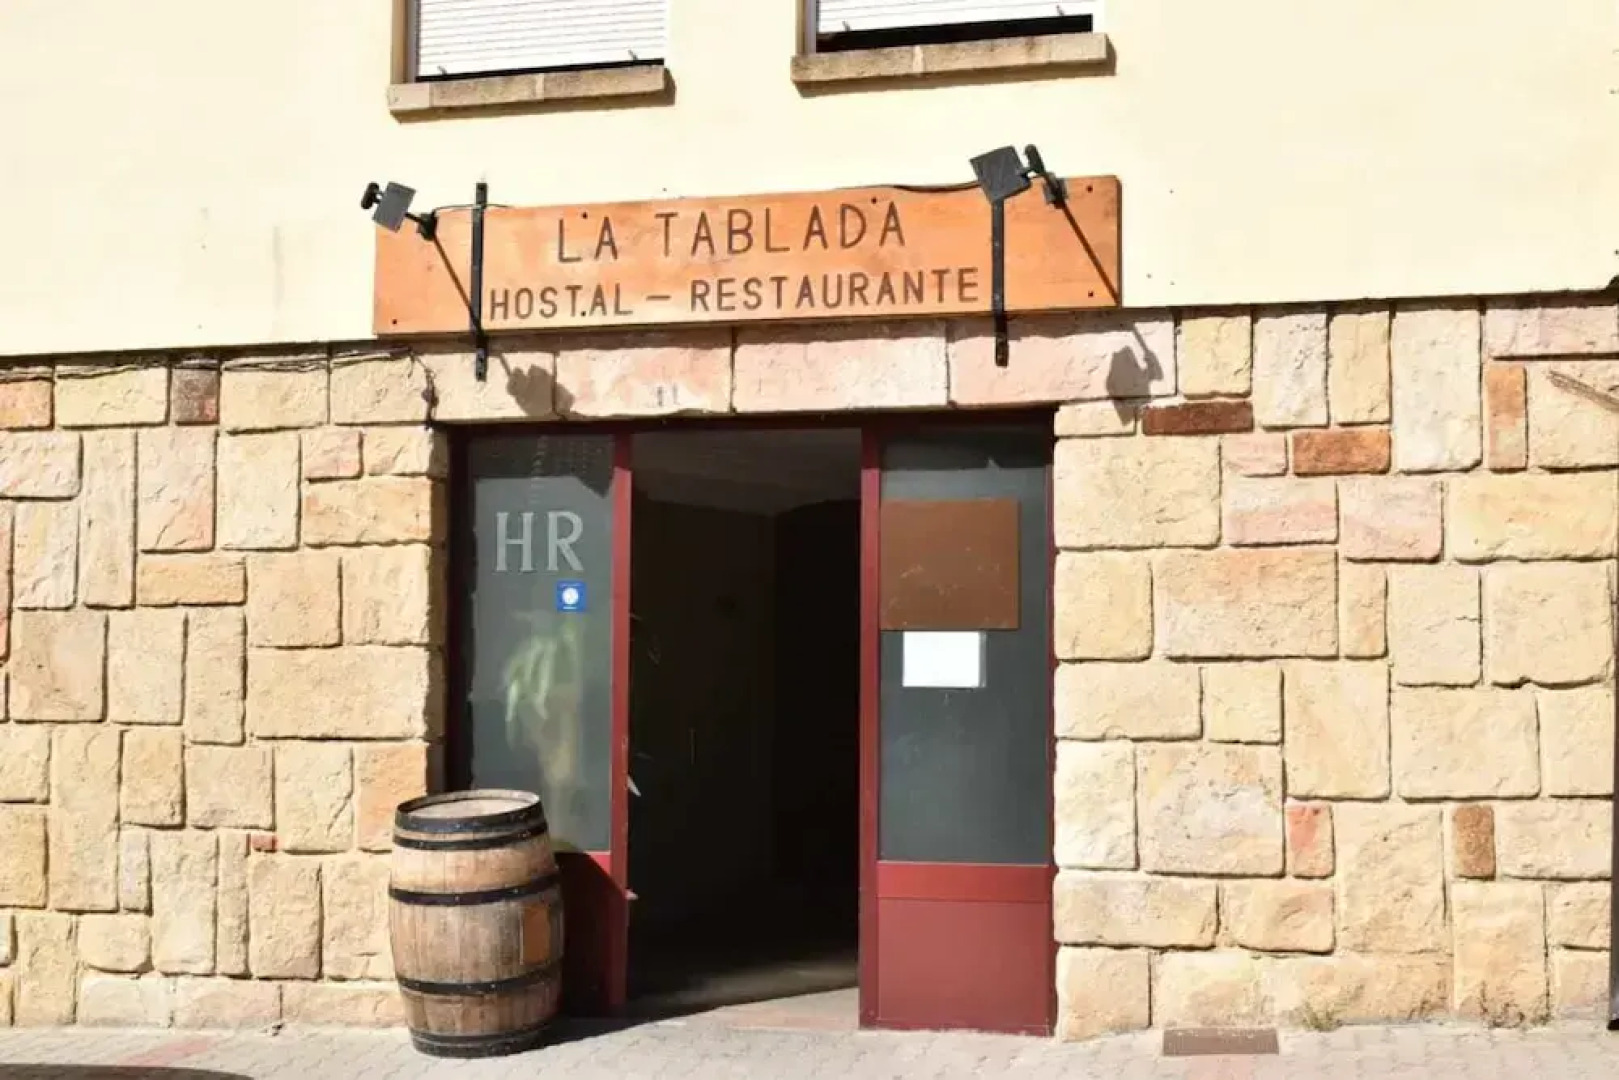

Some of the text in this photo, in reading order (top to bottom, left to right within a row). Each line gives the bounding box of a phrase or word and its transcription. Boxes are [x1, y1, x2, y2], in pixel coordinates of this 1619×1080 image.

[558, 201, 905, 263] LA TABLADA
[489, 283, 633, 320] HOSTAL
[690, 267, 979, 312] RESTAURANTE
[495, 511, 584, 571] HR
